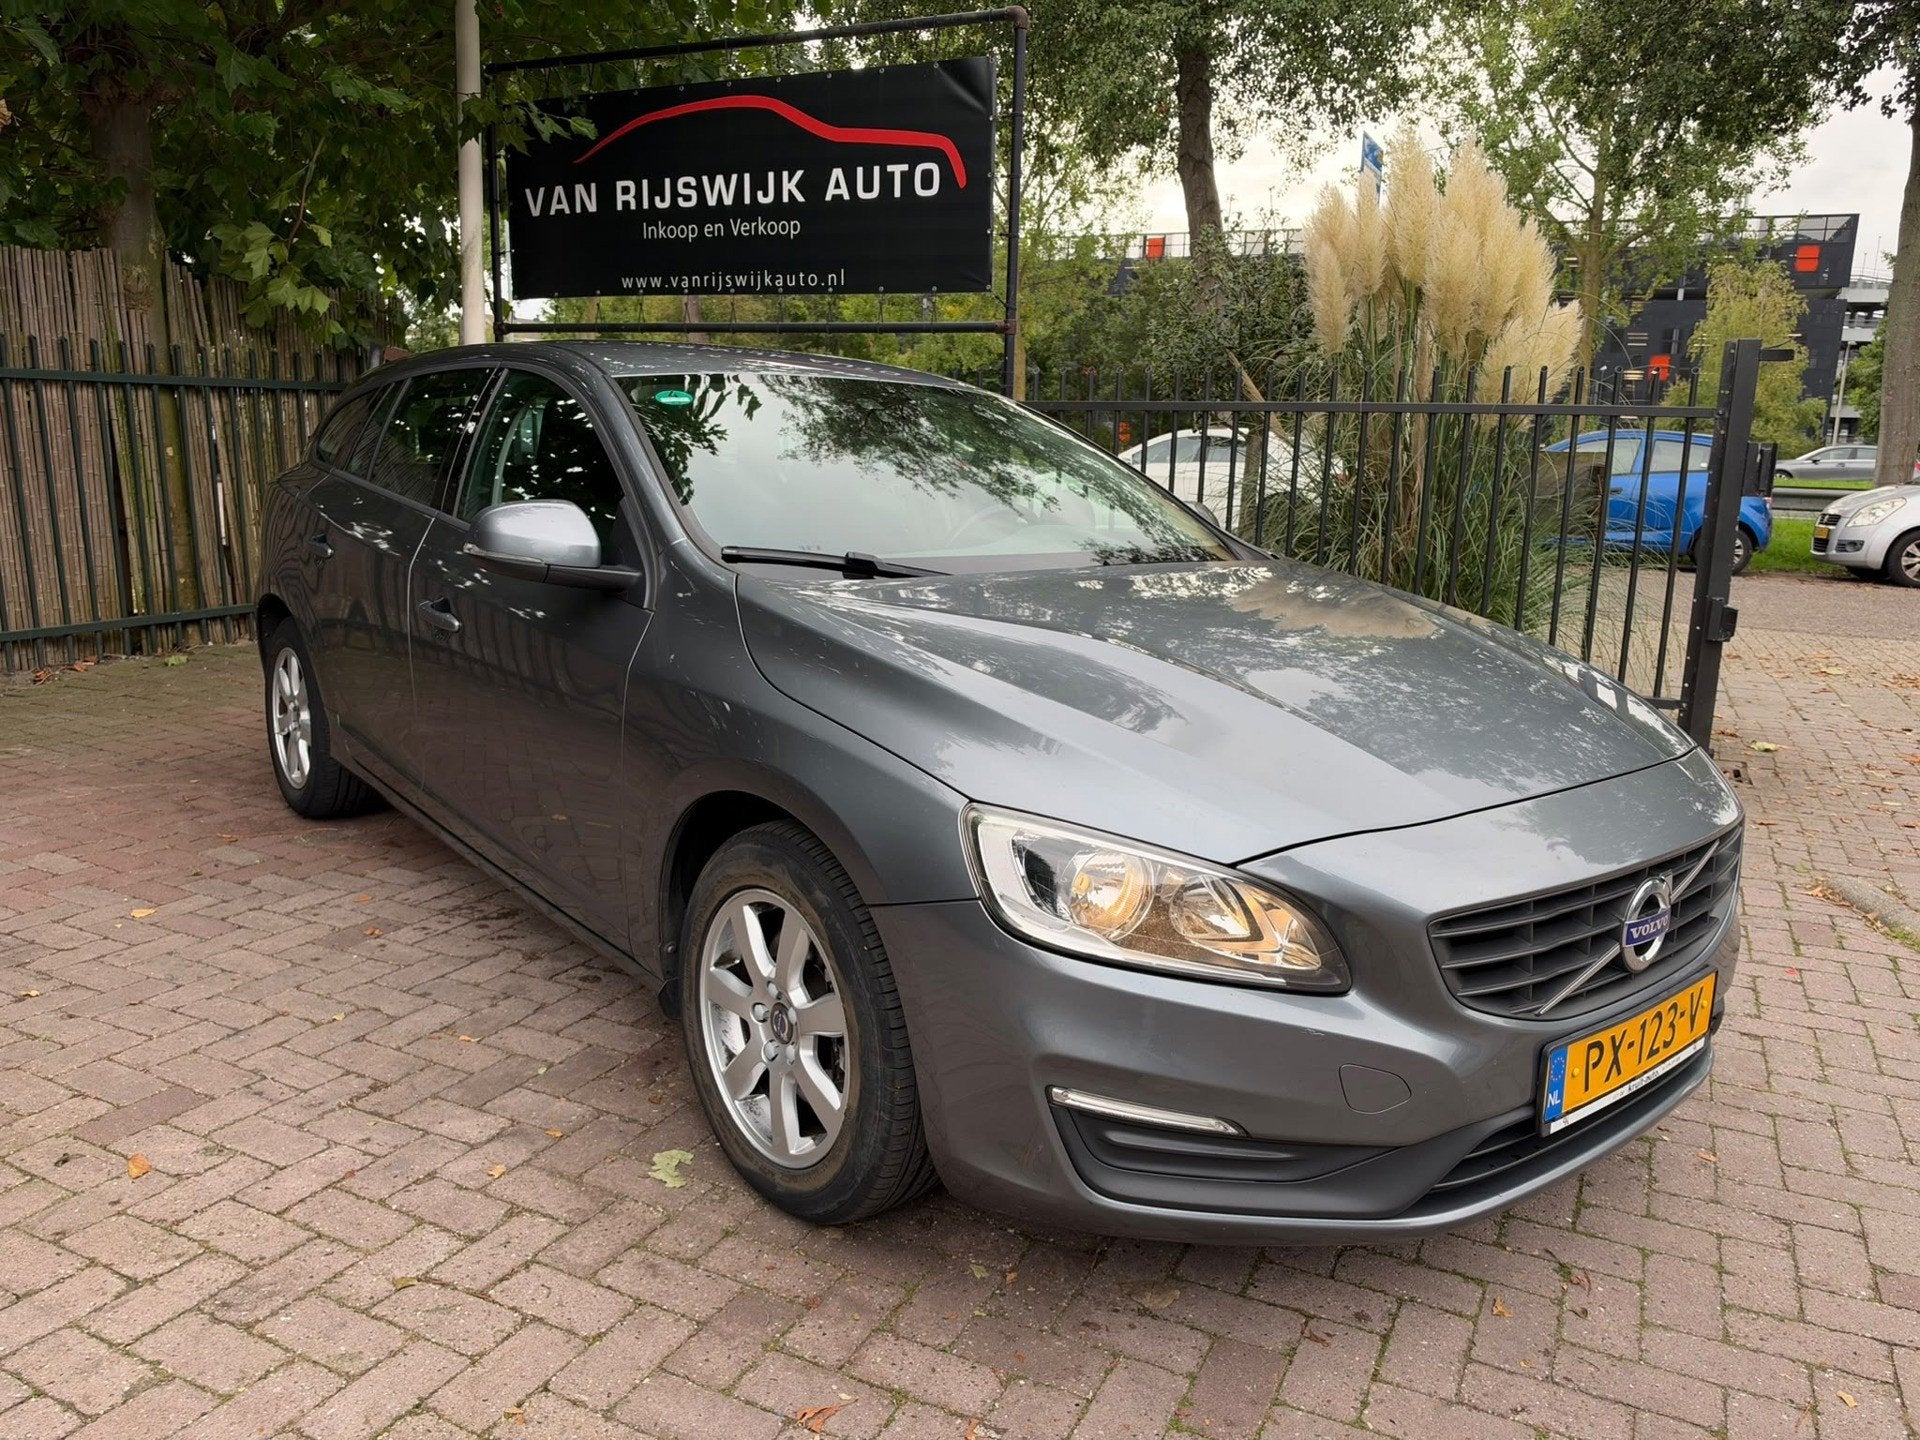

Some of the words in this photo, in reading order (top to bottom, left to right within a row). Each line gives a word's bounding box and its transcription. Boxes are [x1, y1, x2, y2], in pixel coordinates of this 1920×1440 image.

[525, 182, 597, 217] VAN
[616, 169, 806, 211] RIJSWIJK
[825, 162, 940, 202] AUTO
[643, 221, 698, 242] Inkoop
[704, 223, 725, 238] en
[730, 217, 801, 240] Verkoop
[622, 269, 845, 292] www.vanrijswijkauto.nl
[1630, 914, 1669, 939] VOLVO
[1584, 986, 1704, 1092] PX-123-V
[1547, 1089, 1561, 1108] NL
